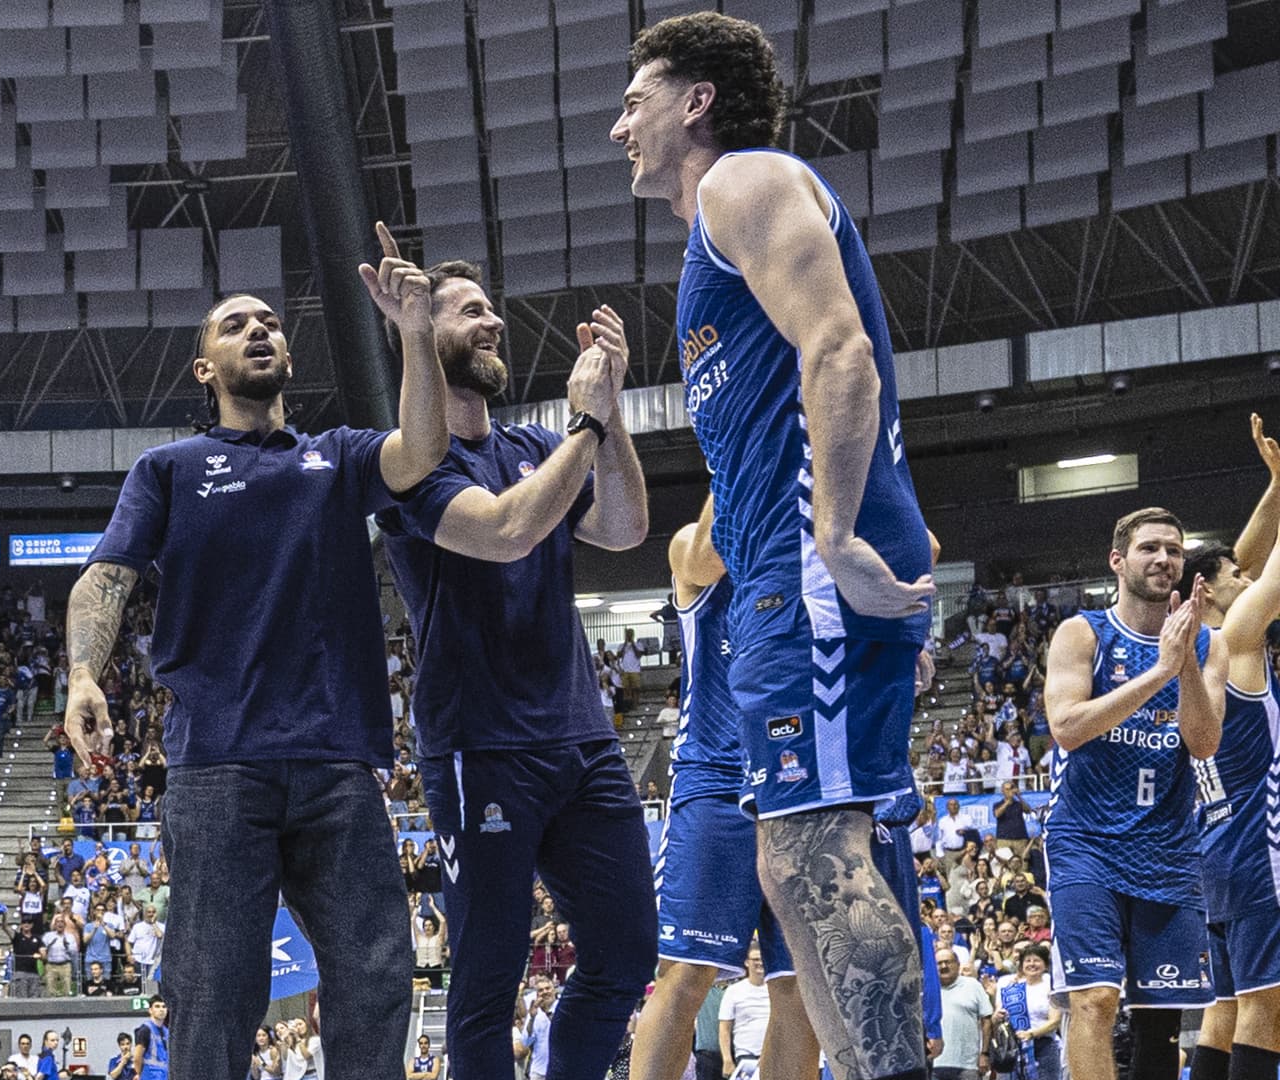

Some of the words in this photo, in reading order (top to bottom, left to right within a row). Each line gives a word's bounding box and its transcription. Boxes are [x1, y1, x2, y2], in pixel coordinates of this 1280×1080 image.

[1109, 727, 1181, 750] BURGO
[1136, 768, 1156, 806] 6
[1137, 979, 1200, 989] LEXUS
